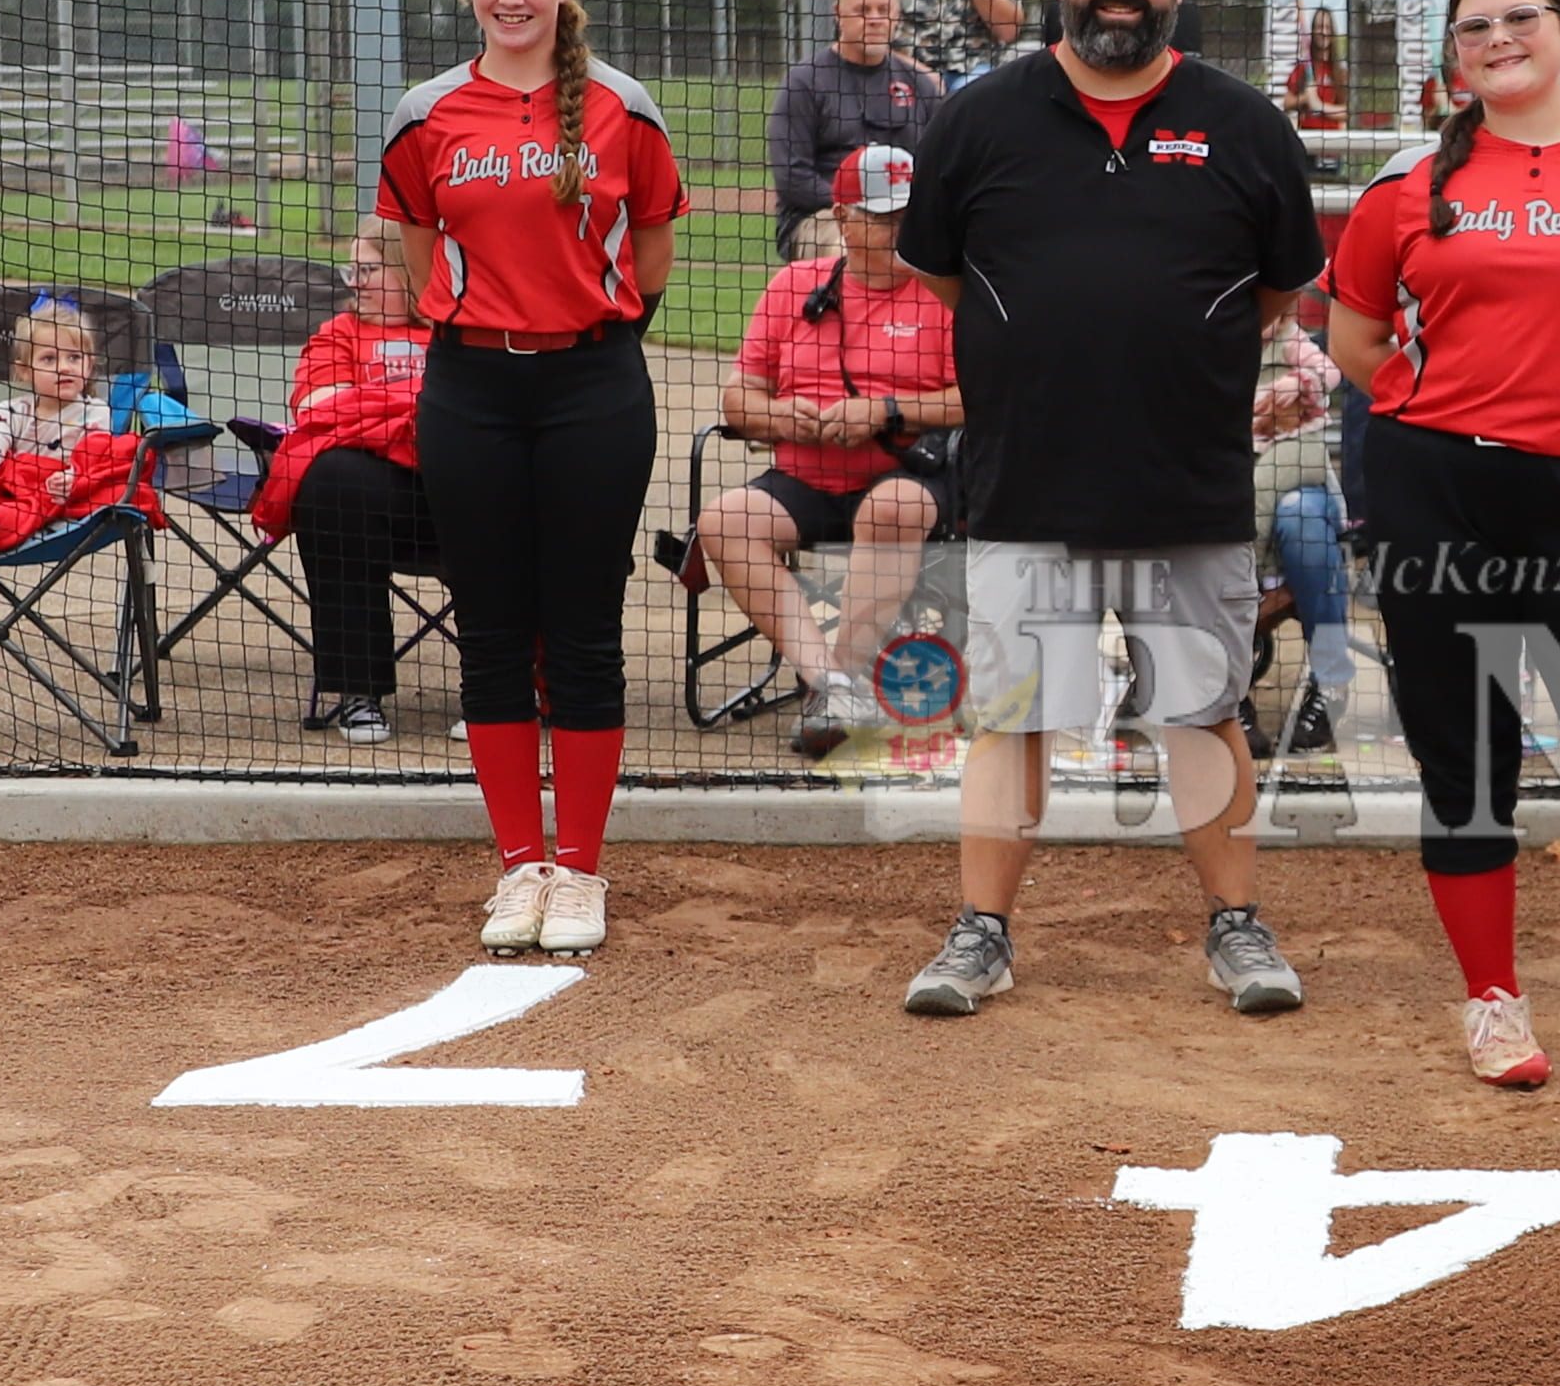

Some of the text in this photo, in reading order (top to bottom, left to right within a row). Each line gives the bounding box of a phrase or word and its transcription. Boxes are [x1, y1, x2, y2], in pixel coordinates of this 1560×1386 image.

[448, 141, 599, 187] Lady Rebls
[578, 193, 592, 240] 7
[149, 965, 589, 1108] 7
